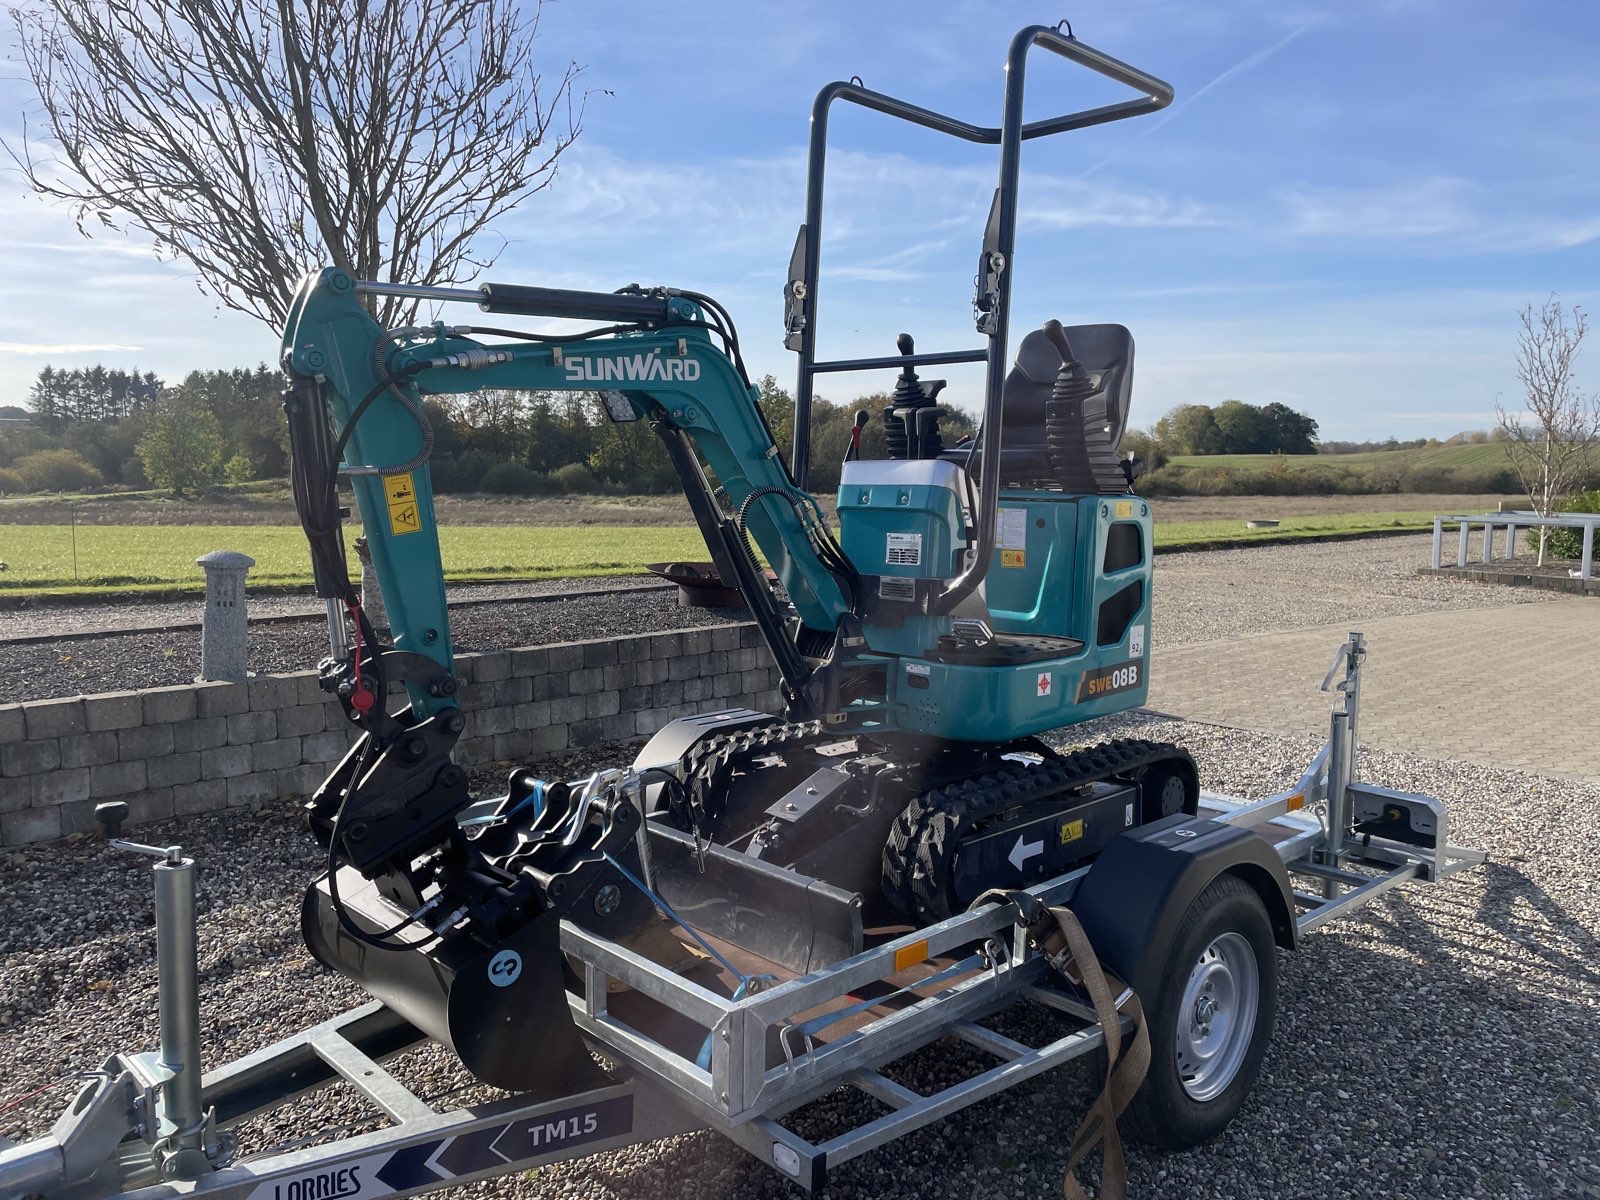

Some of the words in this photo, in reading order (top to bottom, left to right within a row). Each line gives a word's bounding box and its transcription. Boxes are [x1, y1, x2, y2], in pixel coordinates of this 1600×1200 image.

[565, 347, 700, 381] SUNWARD
[1088, 665, 1138, 695] SWE08B
[527, 1112, 598, 1146] TM15
